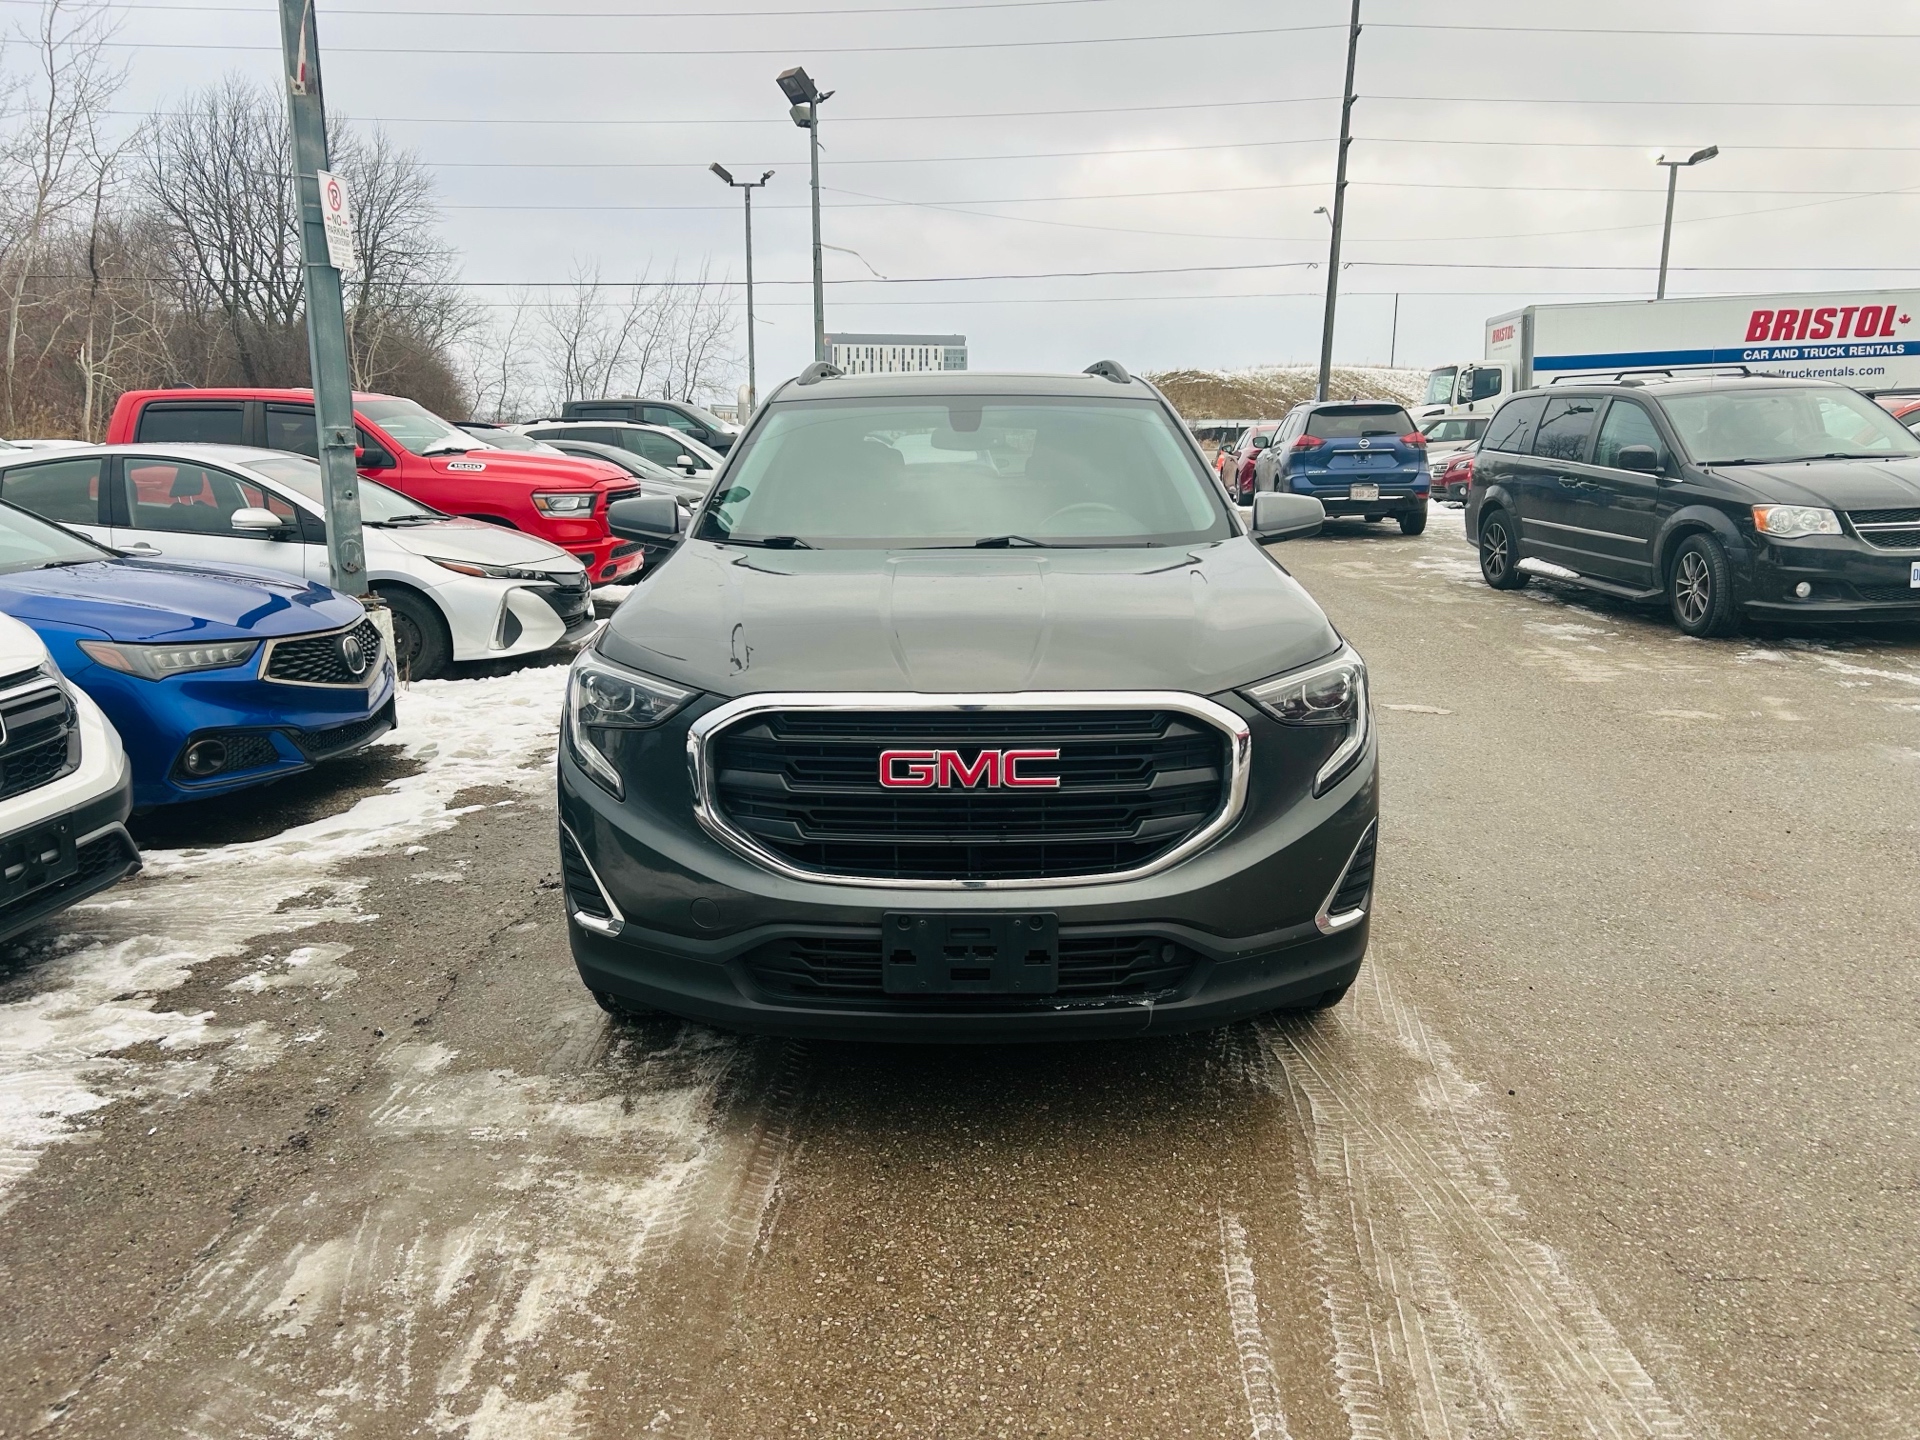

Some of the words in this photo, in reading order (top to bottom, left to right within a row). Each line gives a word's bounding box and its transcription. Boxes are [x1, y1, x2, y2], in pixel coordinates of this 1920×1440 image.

[331, 213, 342, 226] NO
[327, 225, 350, 238] PARKING
[1745, 305, 1897, 342] BRISTOL
[1492, 325, 1513, 344] BRISTOL
[1743, 350, 1769, 360] CAR
[1772, 348, 1798, 359] AND
[1803, 346, 1845, 358] TRUCK
[1849, 344, 1905, 356] RENTALS
[879, 749, 1060, 788] GMC
